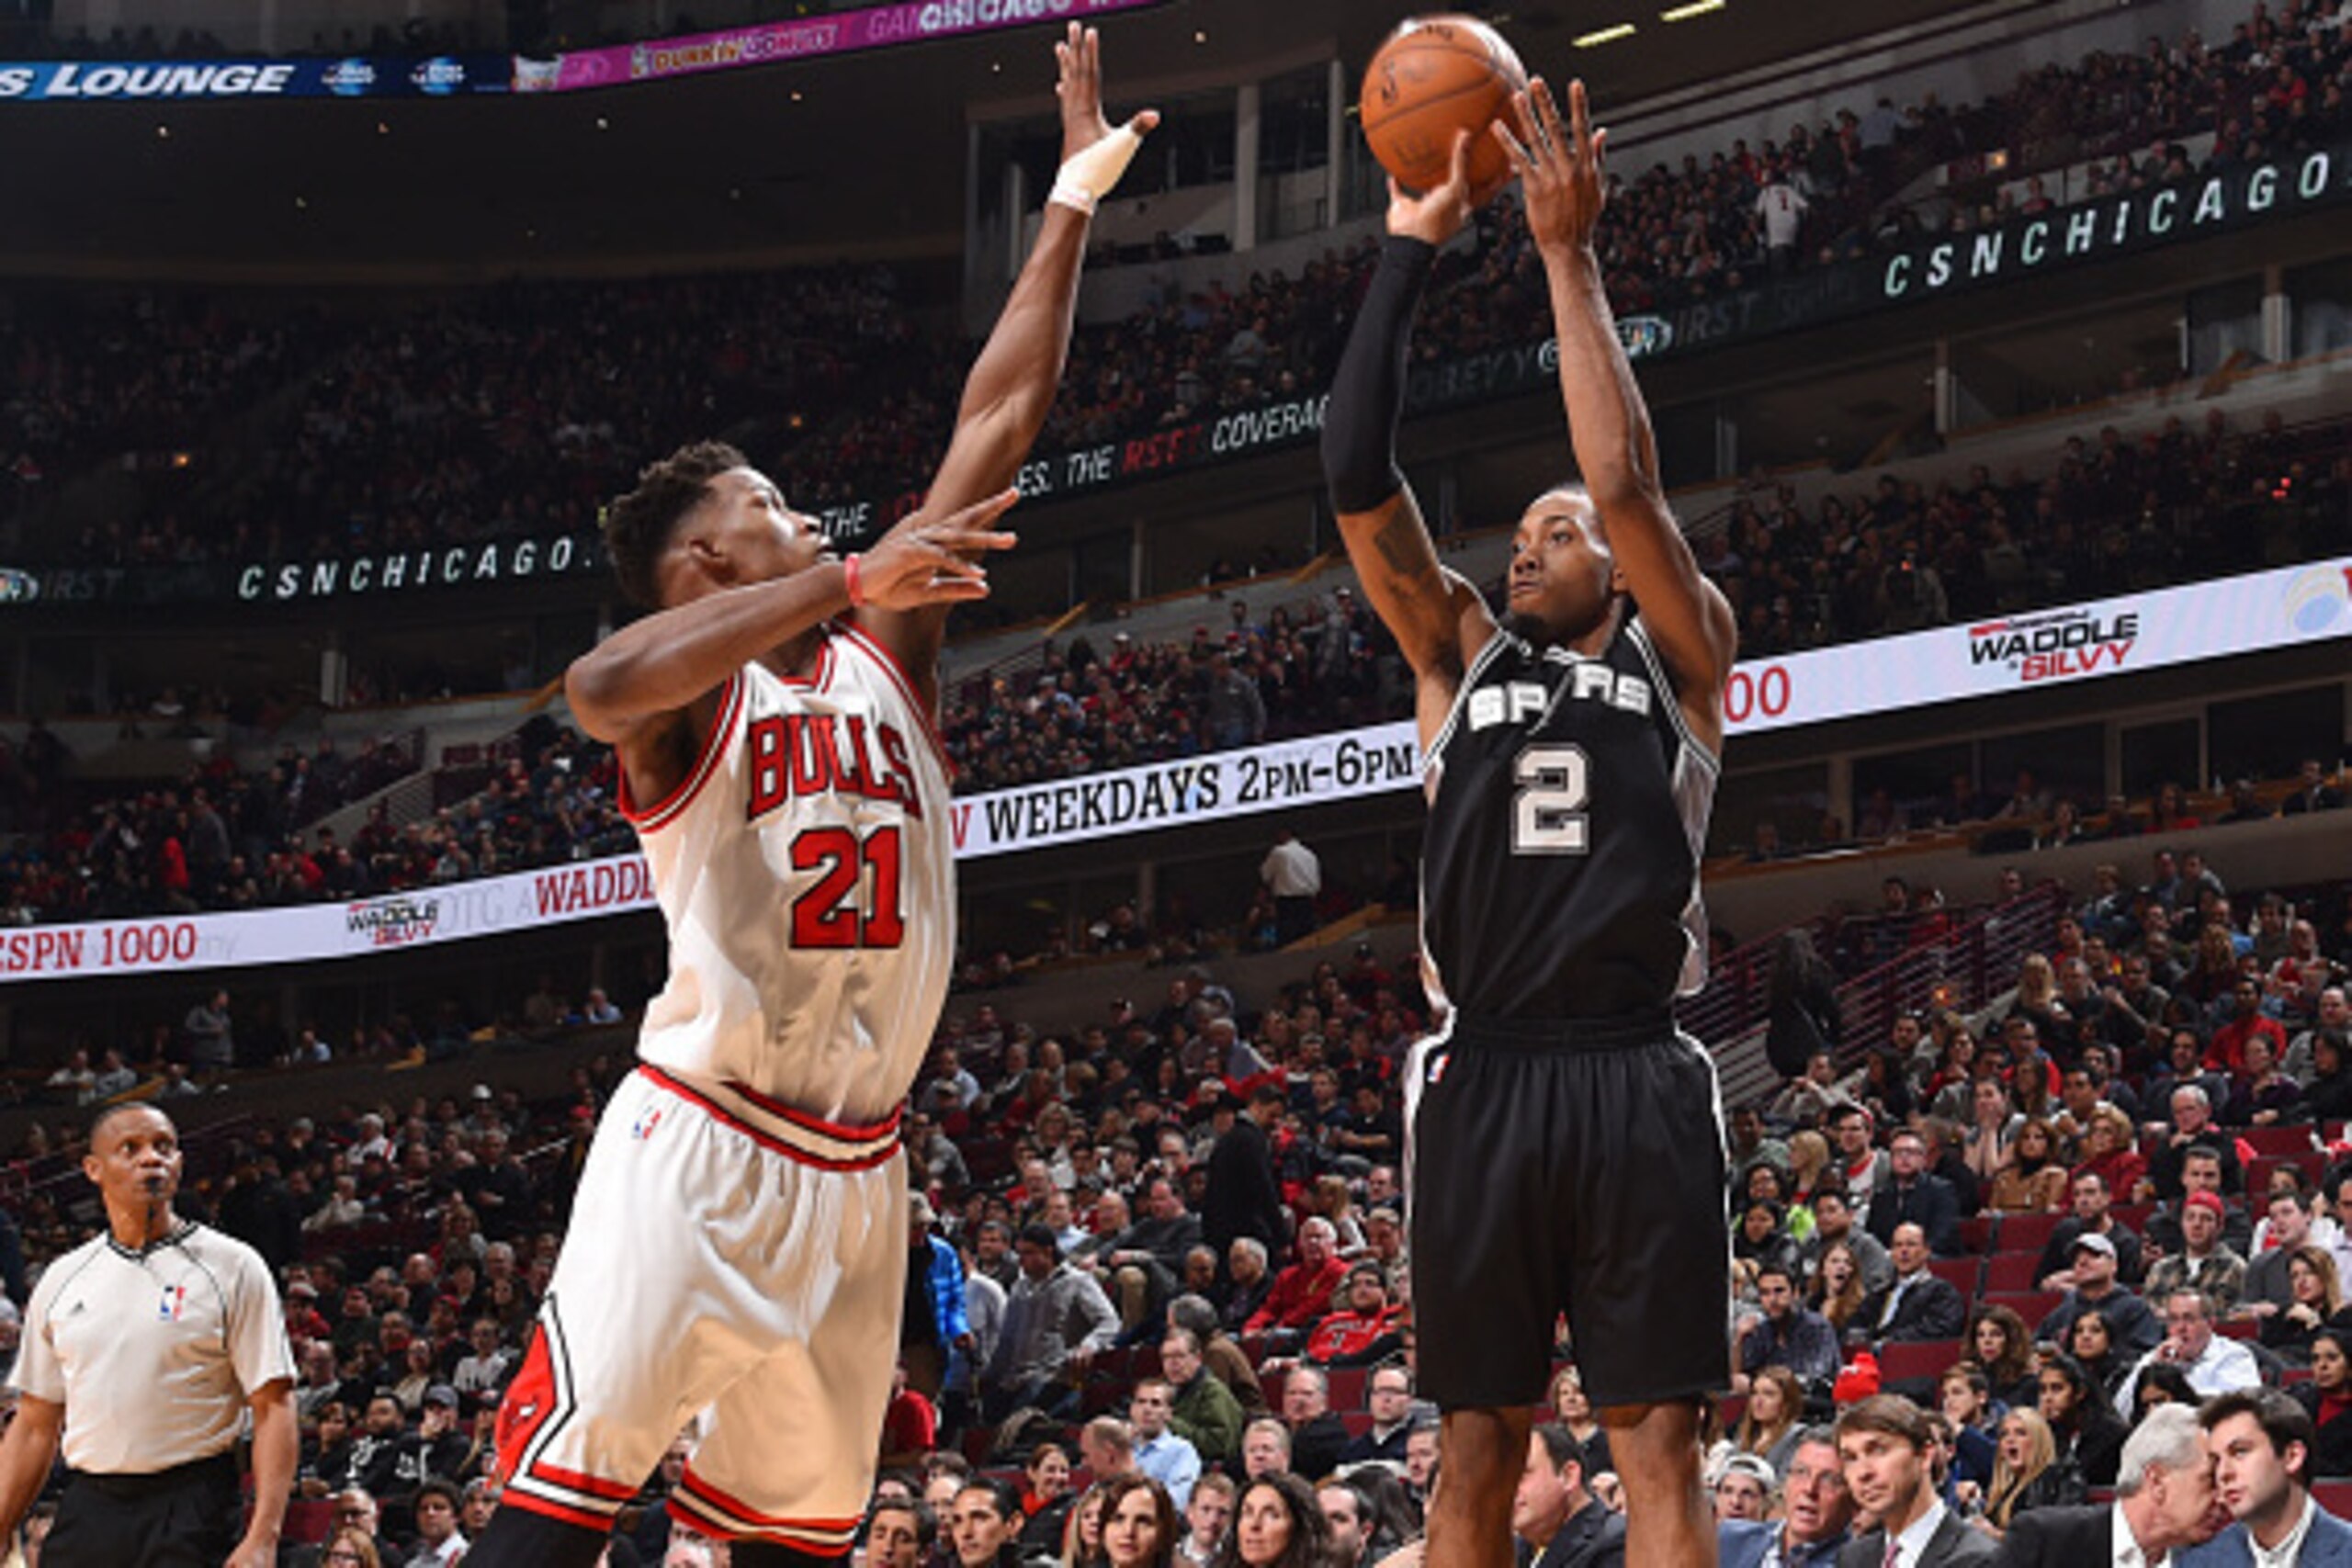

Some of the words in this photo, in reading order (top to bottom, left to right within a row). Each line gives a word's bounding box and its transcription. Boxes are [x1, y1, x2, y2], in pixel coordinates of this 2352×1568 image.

[45, 64, 294, 96] LOUNGE
[1067, 444, 1114, 488] THE
[819, 502, 871, 538] THE
[1971, 614, 2138, 664] WADDLE
[2020, 640, 2132, 682] SILVY
[747, 713, 922, 823] BULLS
[985, 762, 1221, 843] WEEKDAYS
[1510, 740, 1589, 857] 2
[789, 826, 903, 950] 21
[101, 922, 198, 968] 1000
